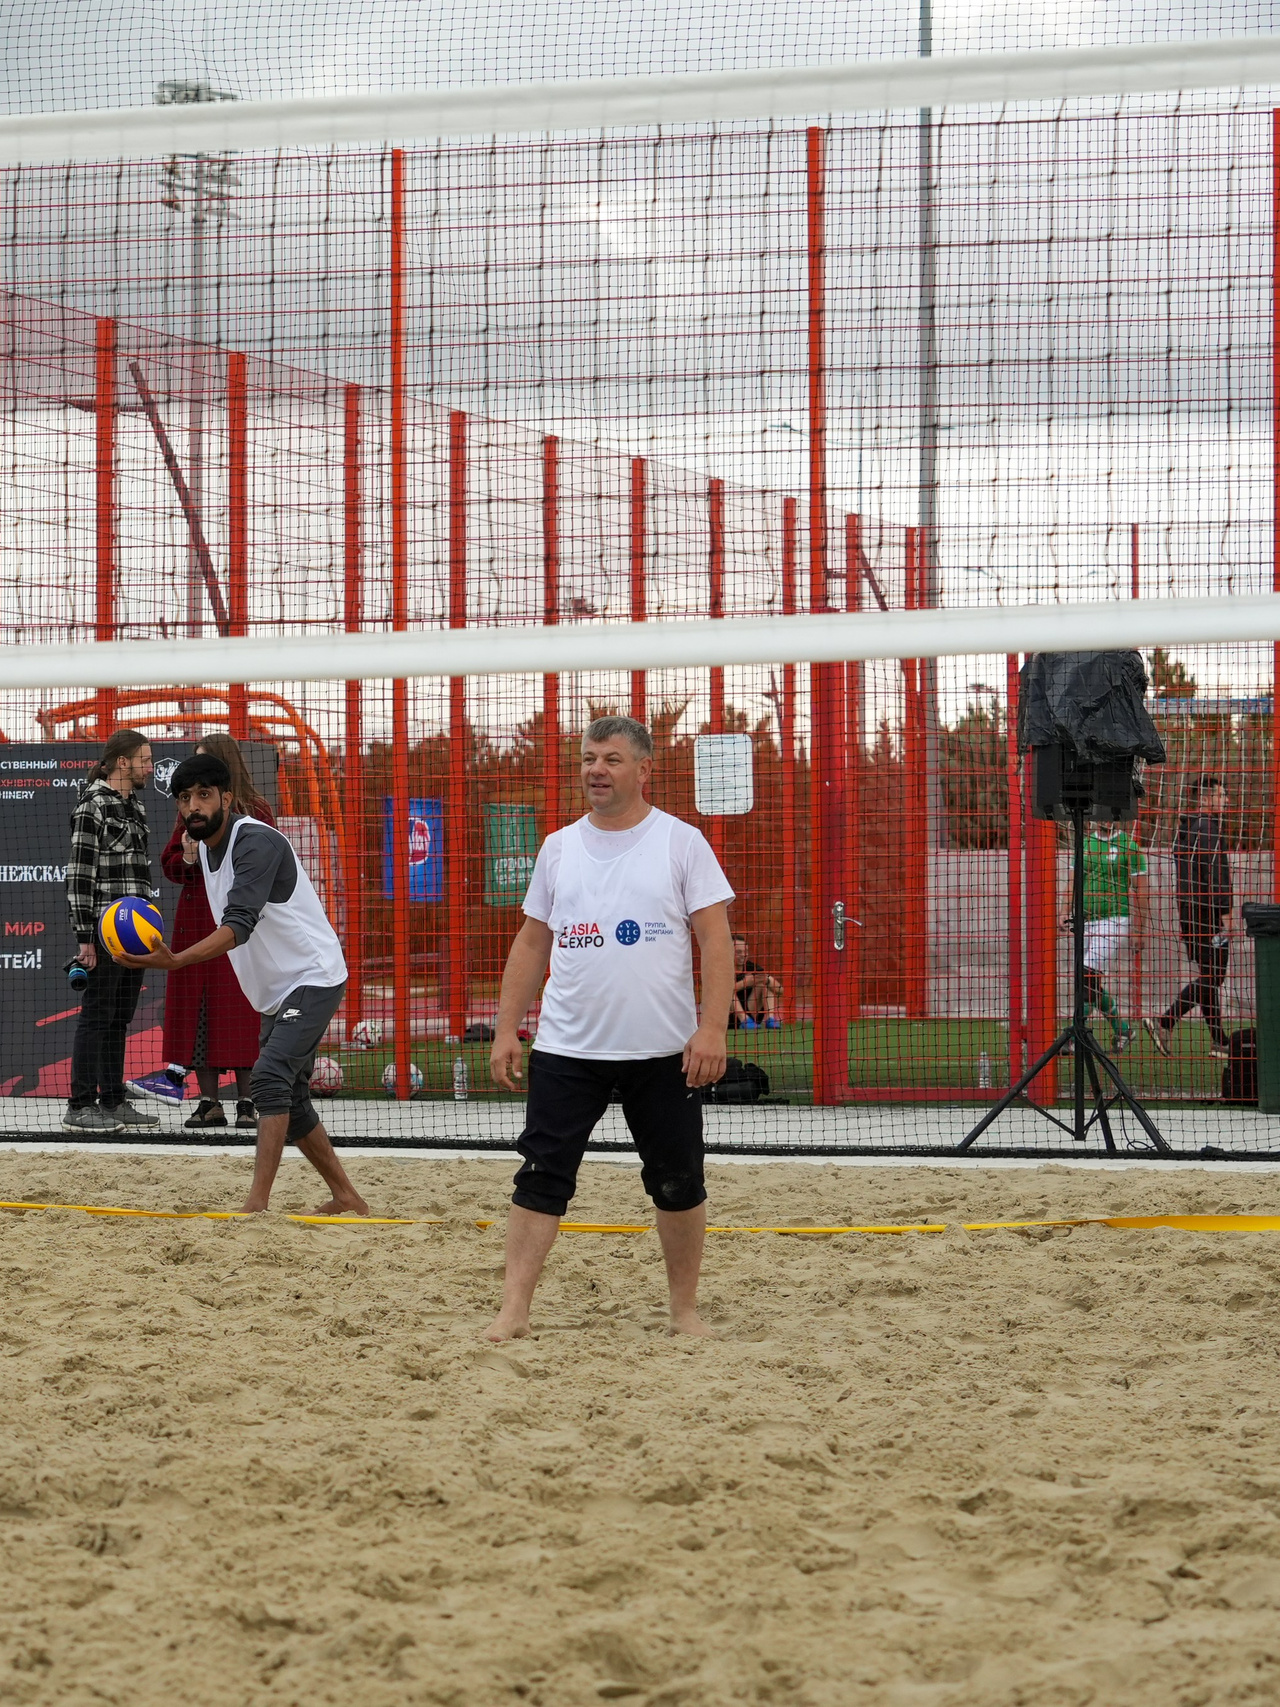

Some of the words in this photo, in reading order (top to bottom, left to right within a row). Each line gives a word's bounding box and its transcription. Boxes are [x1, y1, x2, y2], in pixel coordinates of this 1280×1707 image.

[52, 778, 68, 788] ON
[570, 923, 600, 936] ASIA
[569, 935, 604, 948] EXPO
